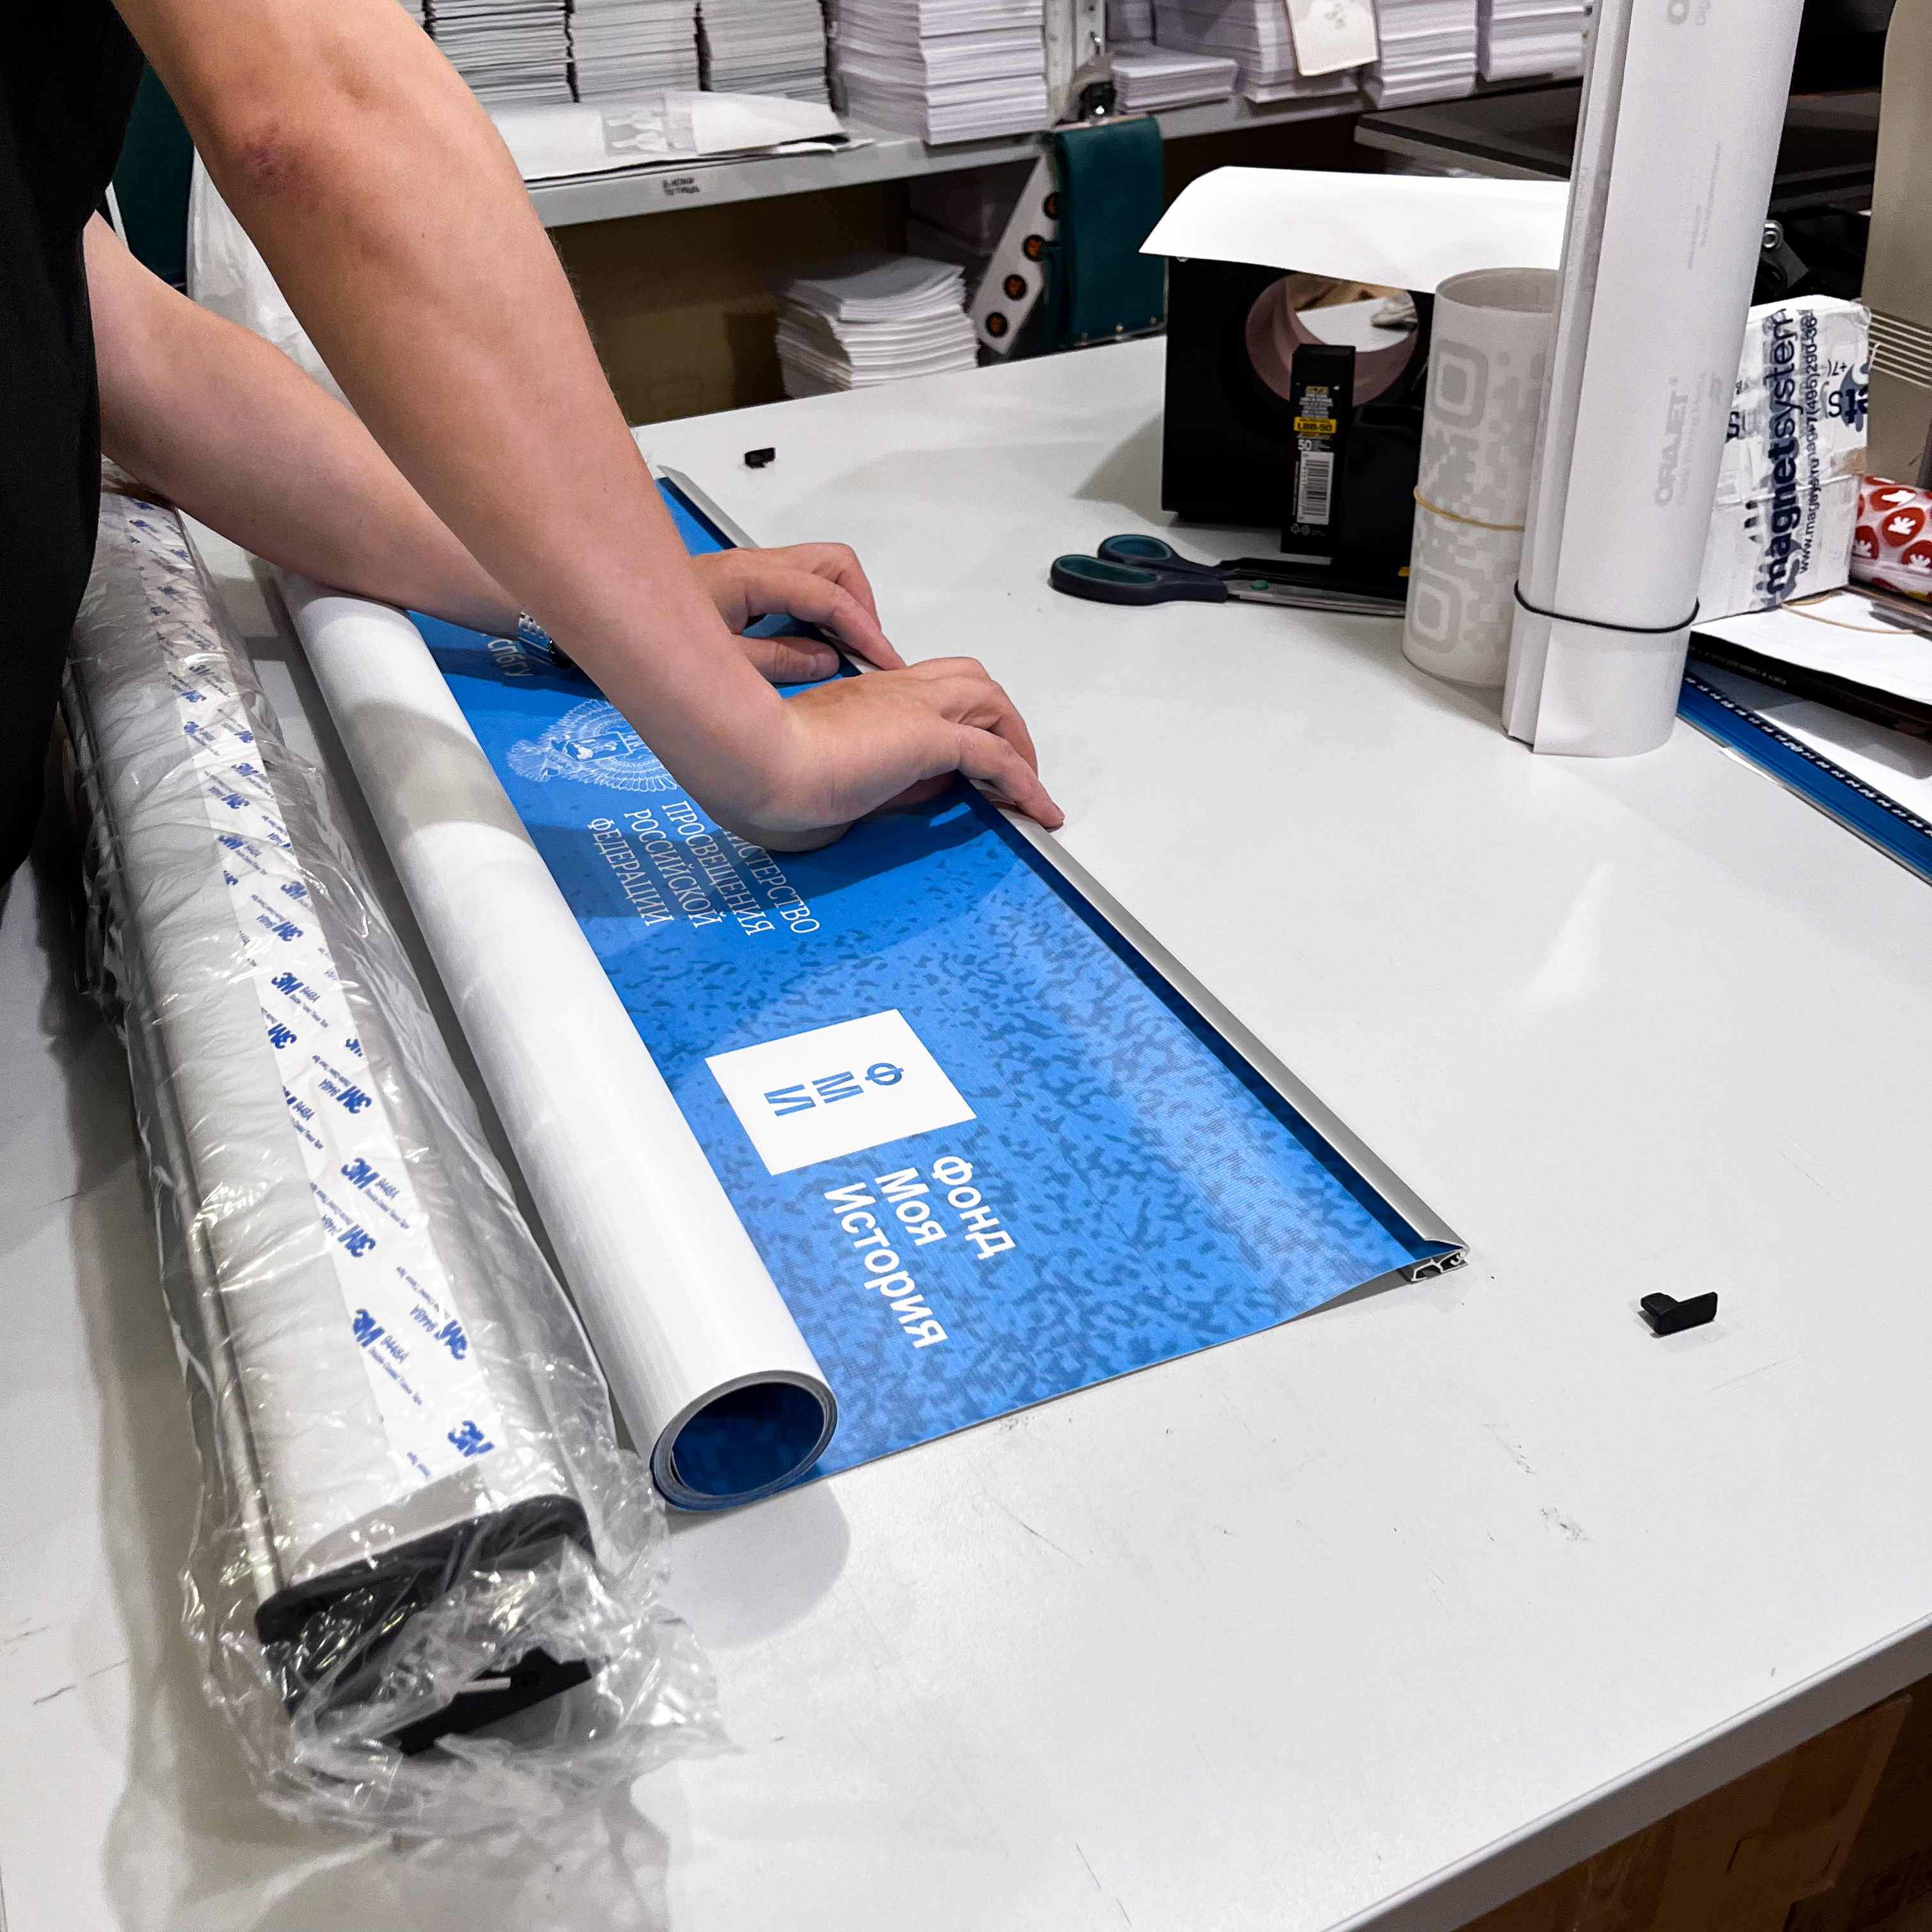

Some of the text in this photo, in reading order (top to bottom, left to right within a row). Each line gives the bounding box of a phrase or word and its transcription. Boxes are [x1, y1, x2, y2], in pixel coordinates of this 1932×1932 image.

[1298, 439, 1312, 451] 50
[587, 818, 675, 927] ФЕДЕРАЦИИ
[624, 808, 727, 928] РОССИЙСКОЙ
[662, 800, 776, 937] ПРОСВЕЩЕНИЯ
[272, 921, 303, 942] 3M
[271, 972, 305, 995] 3M
[268, 1022, 297, 1049] 3M
[335, 1085, 372, 1114] 3M
[341, 1157, 381, 1190] 3M
[874, 1167, 947, 1246] Моя
[931, 1155, 1016, 1261] Фонд
[337, 1217, 378, 1258] 3M
[824, 1182, 949, 1349] История
[433, 1319, 468, 1361] 3M
[447, 1420, 495, 1458] 3M
